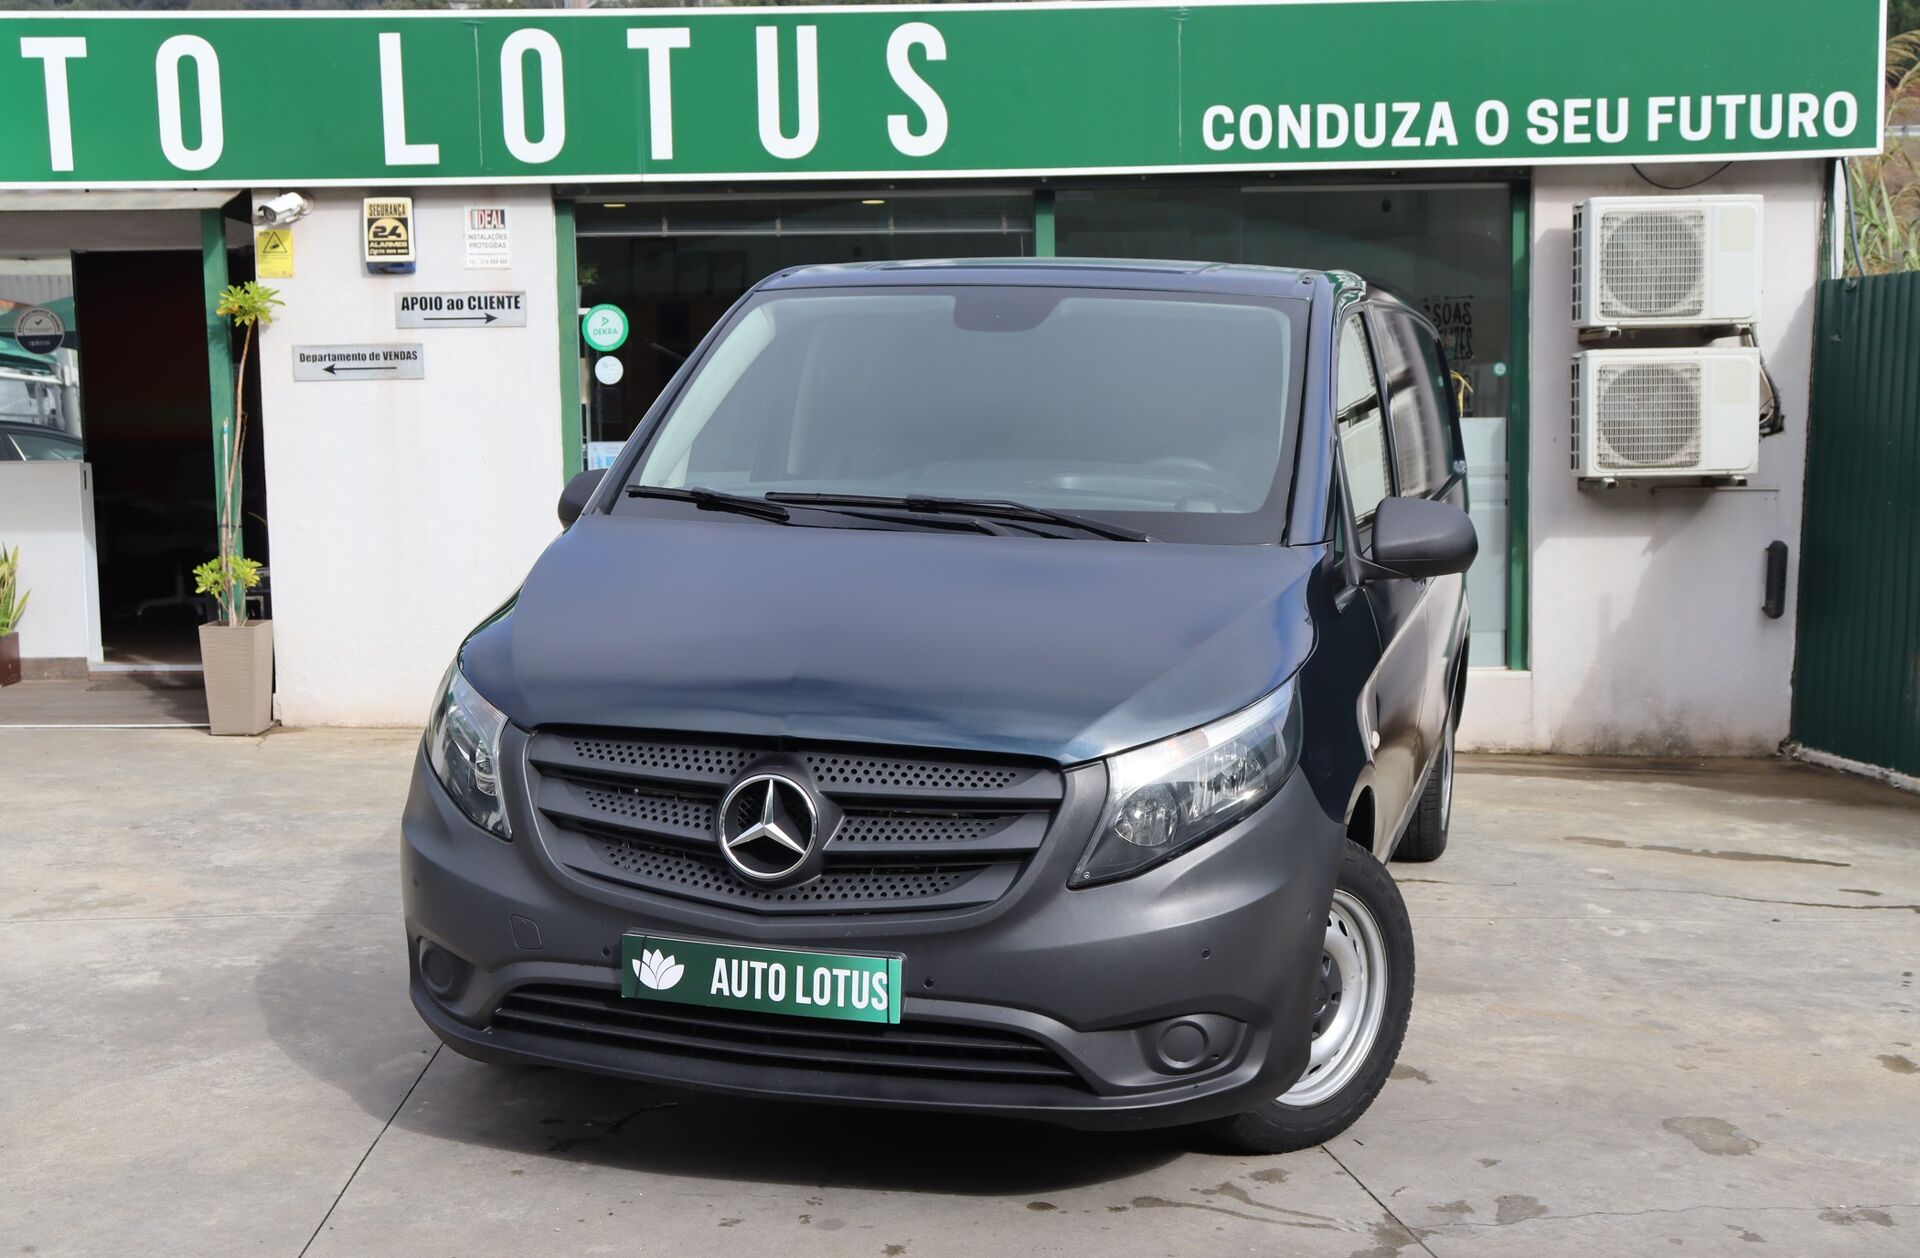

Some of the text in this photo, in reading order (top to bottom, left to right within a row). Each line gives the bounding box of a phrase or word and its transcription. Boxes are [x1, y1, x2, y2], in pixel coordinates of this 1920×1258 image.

[20, 21, 949, 172] TO LOTUS
[1202, 90, 1858, 151] CONDUZA O SEU FUTURO
[372, 225, 402, 239] 24
[401, 295, 521, 311] APOIO ao CLIENTE
[592, 328, 618, 337] DEKRA
[299, 351, 418, 363] Departamento de VENDAS
[710, 957, 888, 1011] AUTO LOTUS
